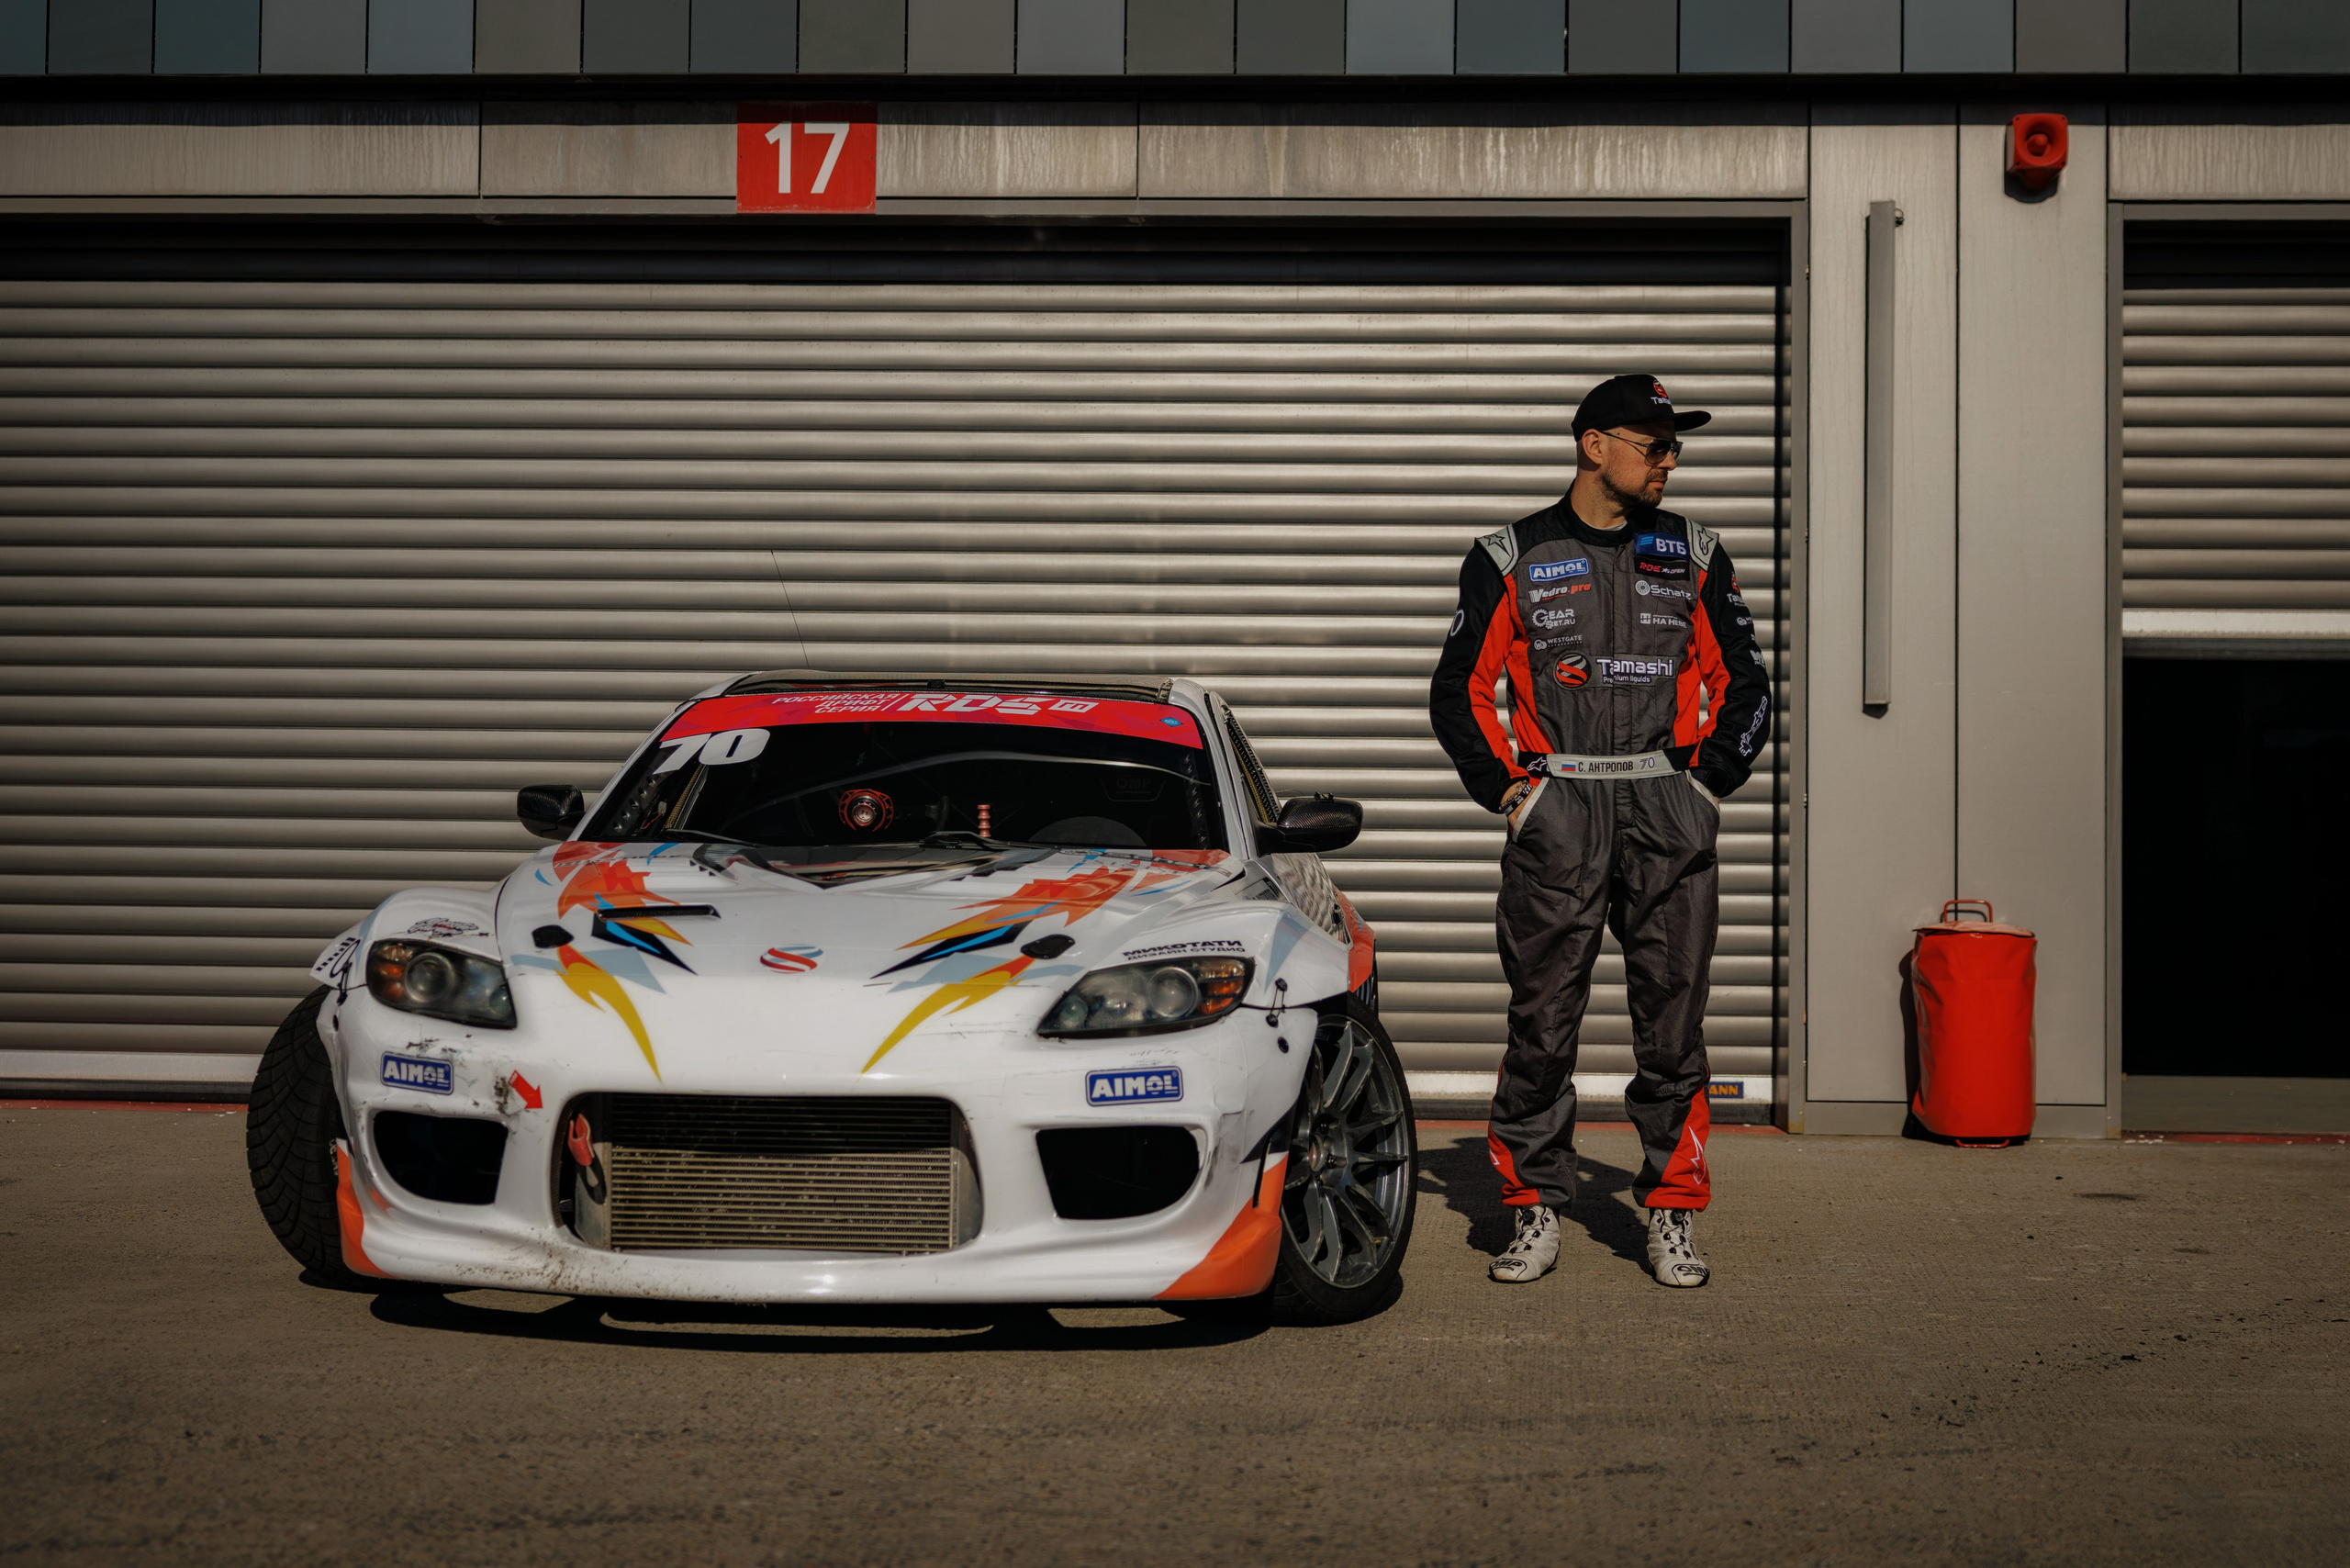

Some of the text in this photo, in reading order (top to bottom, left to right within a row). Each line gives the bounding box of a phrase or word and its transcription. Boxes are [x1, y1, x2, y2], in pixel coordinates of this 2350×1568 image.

[764, 120, 850, 195] 17
[1655, 538, 1687, 555] ВТБ
[1528, 583, 1591, 603] Vedro.pro
[1651, 584, 1692, 600] Schatz
[1548, 634, 1583, 644] WESTGATE
[1596, 658, 1673, 676] Tamashi
[1629, 674, 1651, 683] liquids
[771, 693, 901, 704] РОССИЙСКАЯ
[814, 700, 890, 708] ДРИФТ
[896, 693, 1056, 715] RDS
[815, 705, 881, 713] СЕРИЯ
[652, 728, 771, 775] 70
[1578, 756, 1656, 773] С. АНТРОПОВ 70
[1123, 940, 1243, 957] МИКОТАТИ
